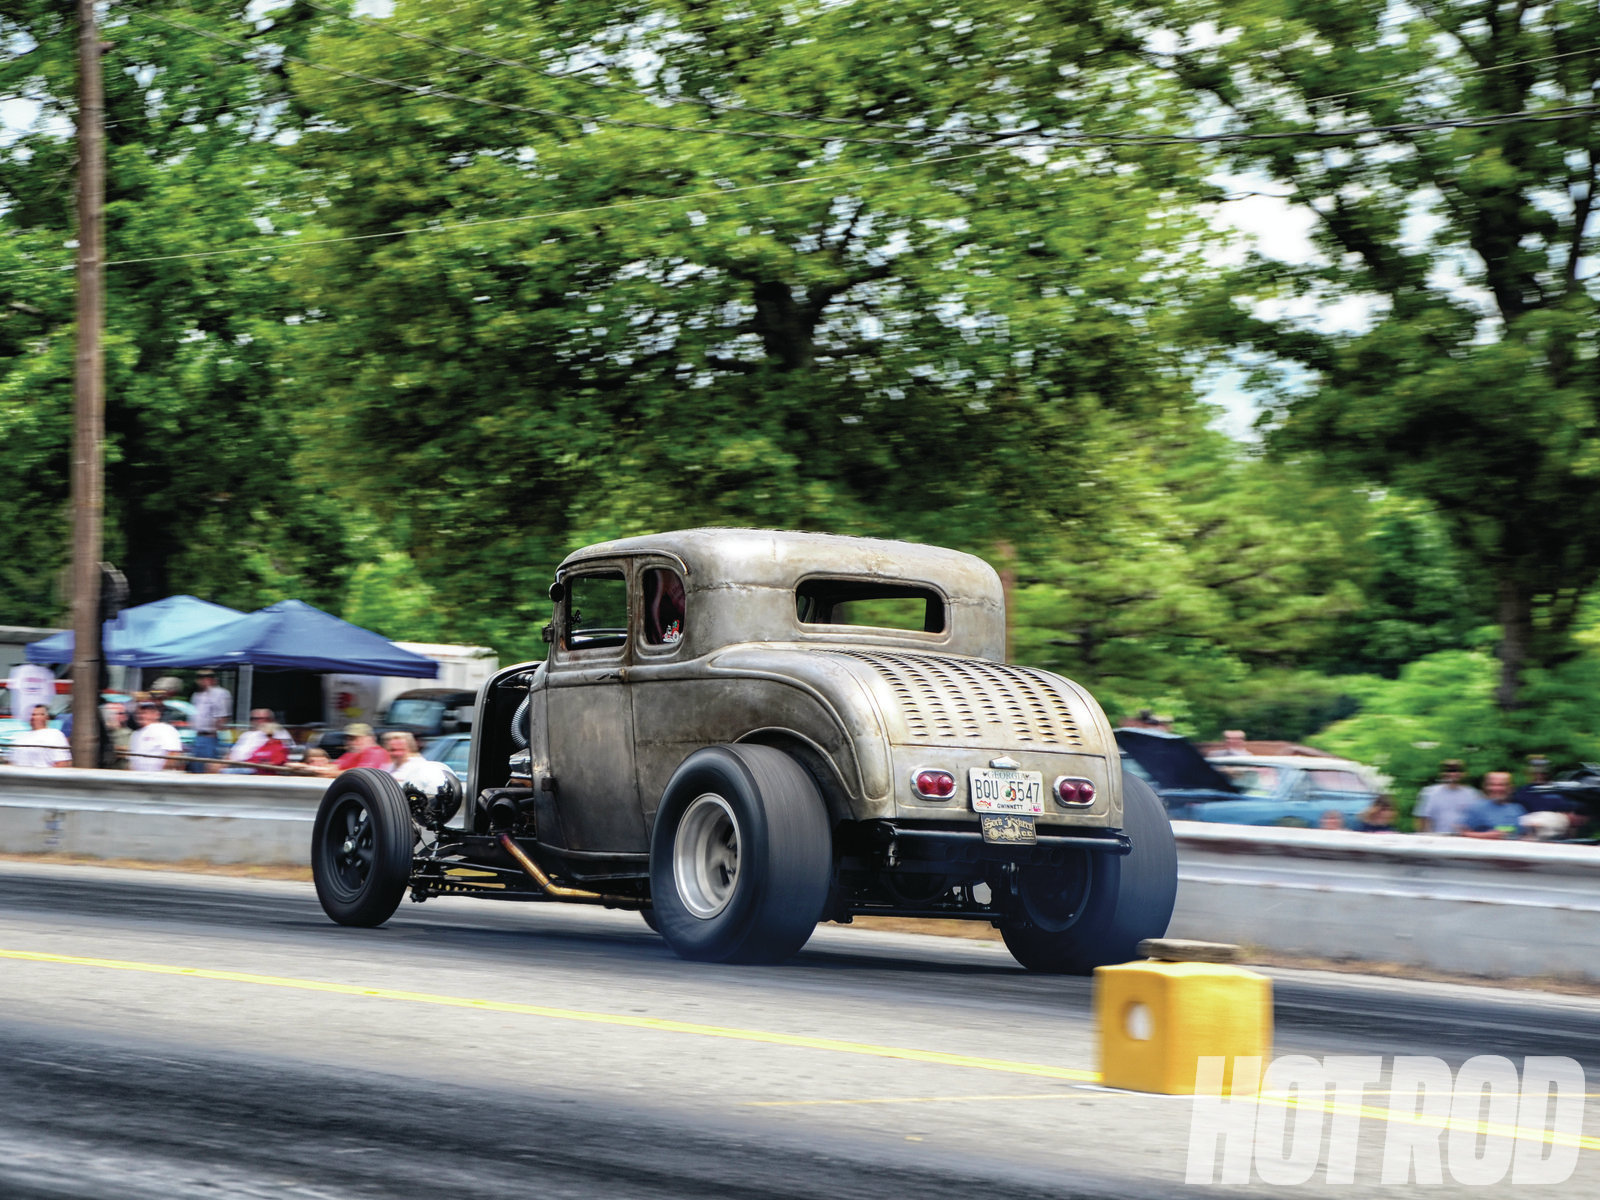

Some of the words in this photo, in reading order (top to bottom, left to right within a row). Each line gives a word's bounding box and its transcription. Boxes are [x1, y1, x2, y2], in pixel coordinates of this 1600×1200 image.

[987, 770, 1028, 781] GEORGIA
[975, 779, 999, 800] BQU
[1009, 781, 1040, 802] 5547
